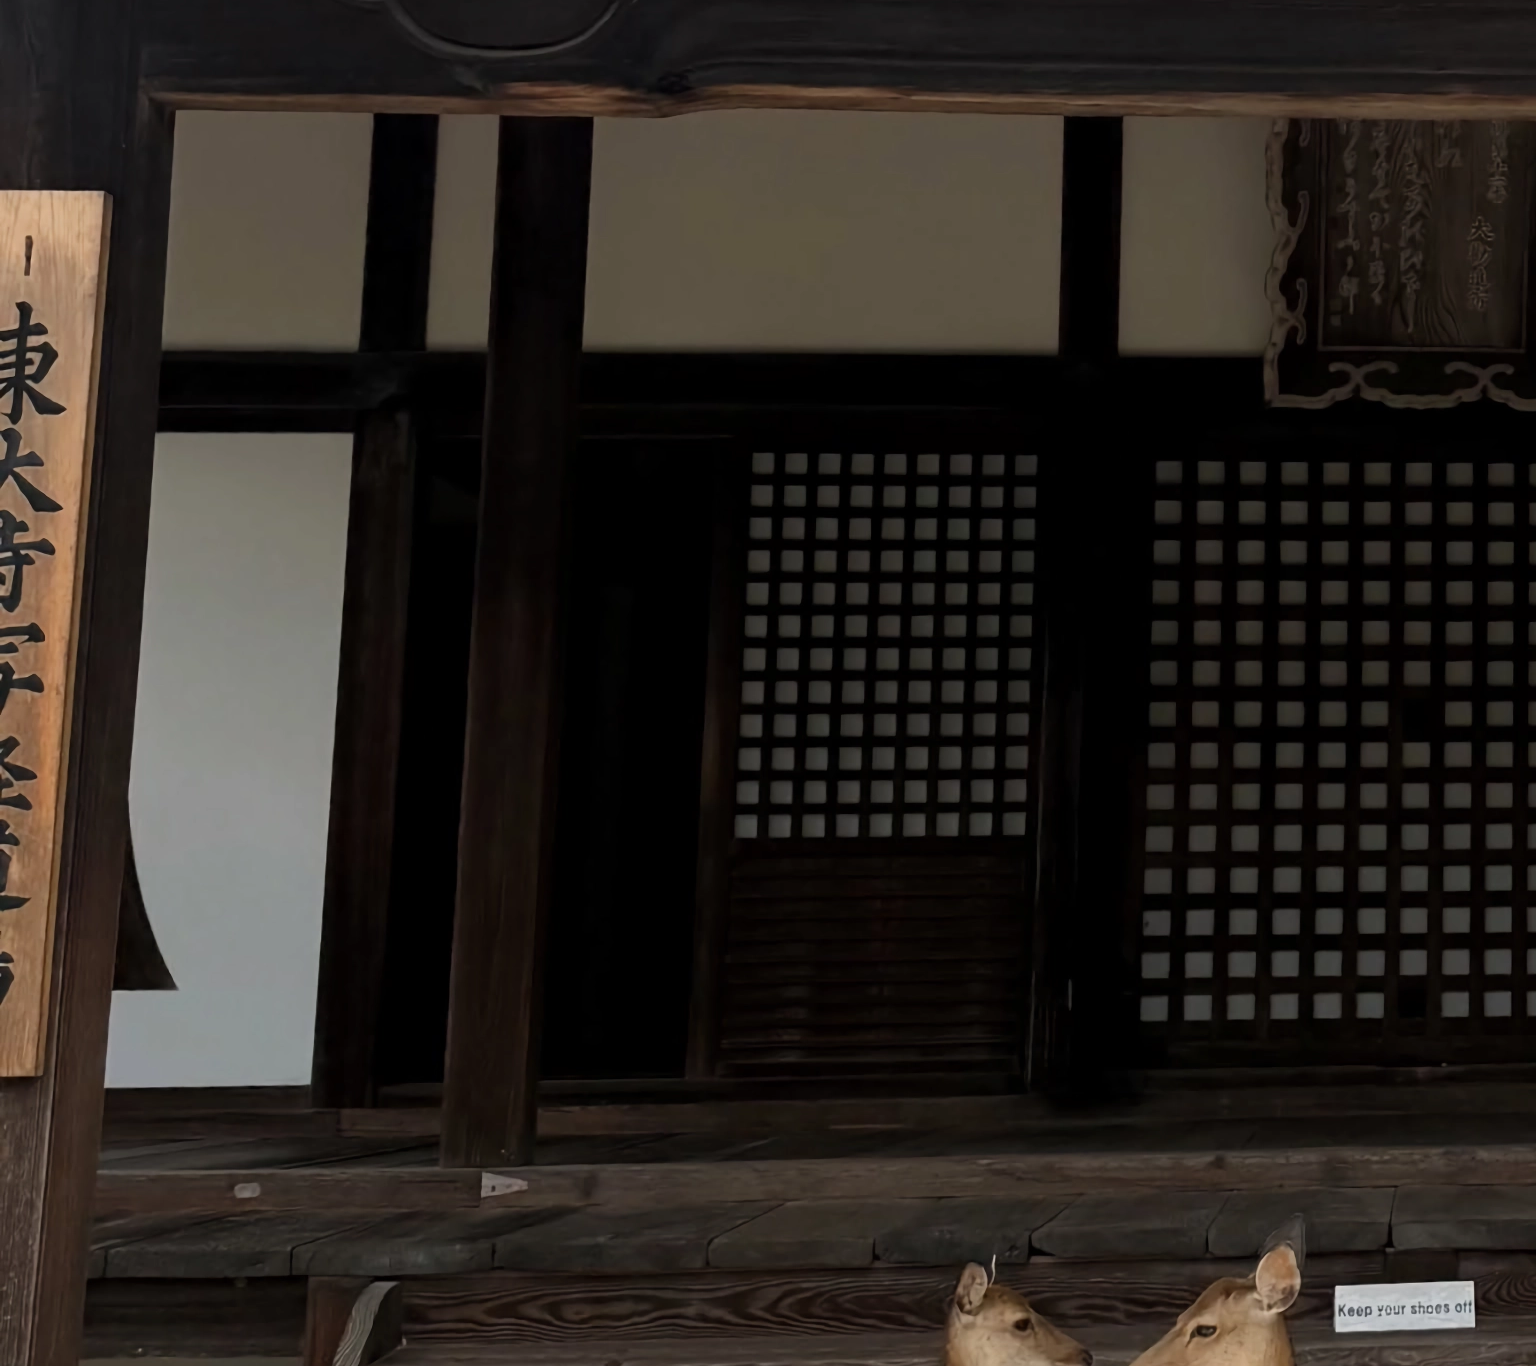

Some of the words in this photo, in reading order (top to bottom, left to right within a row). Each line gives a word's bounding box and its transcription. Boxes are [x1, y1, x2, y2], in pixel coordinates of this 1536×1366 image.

[1337, 1303, 1373, 1318] Keep
[1377, 1304, 1406, 1318] your
[1410, 1301, 1450, 1315] shoes
[1454, 1299, 1473, 1314] off
